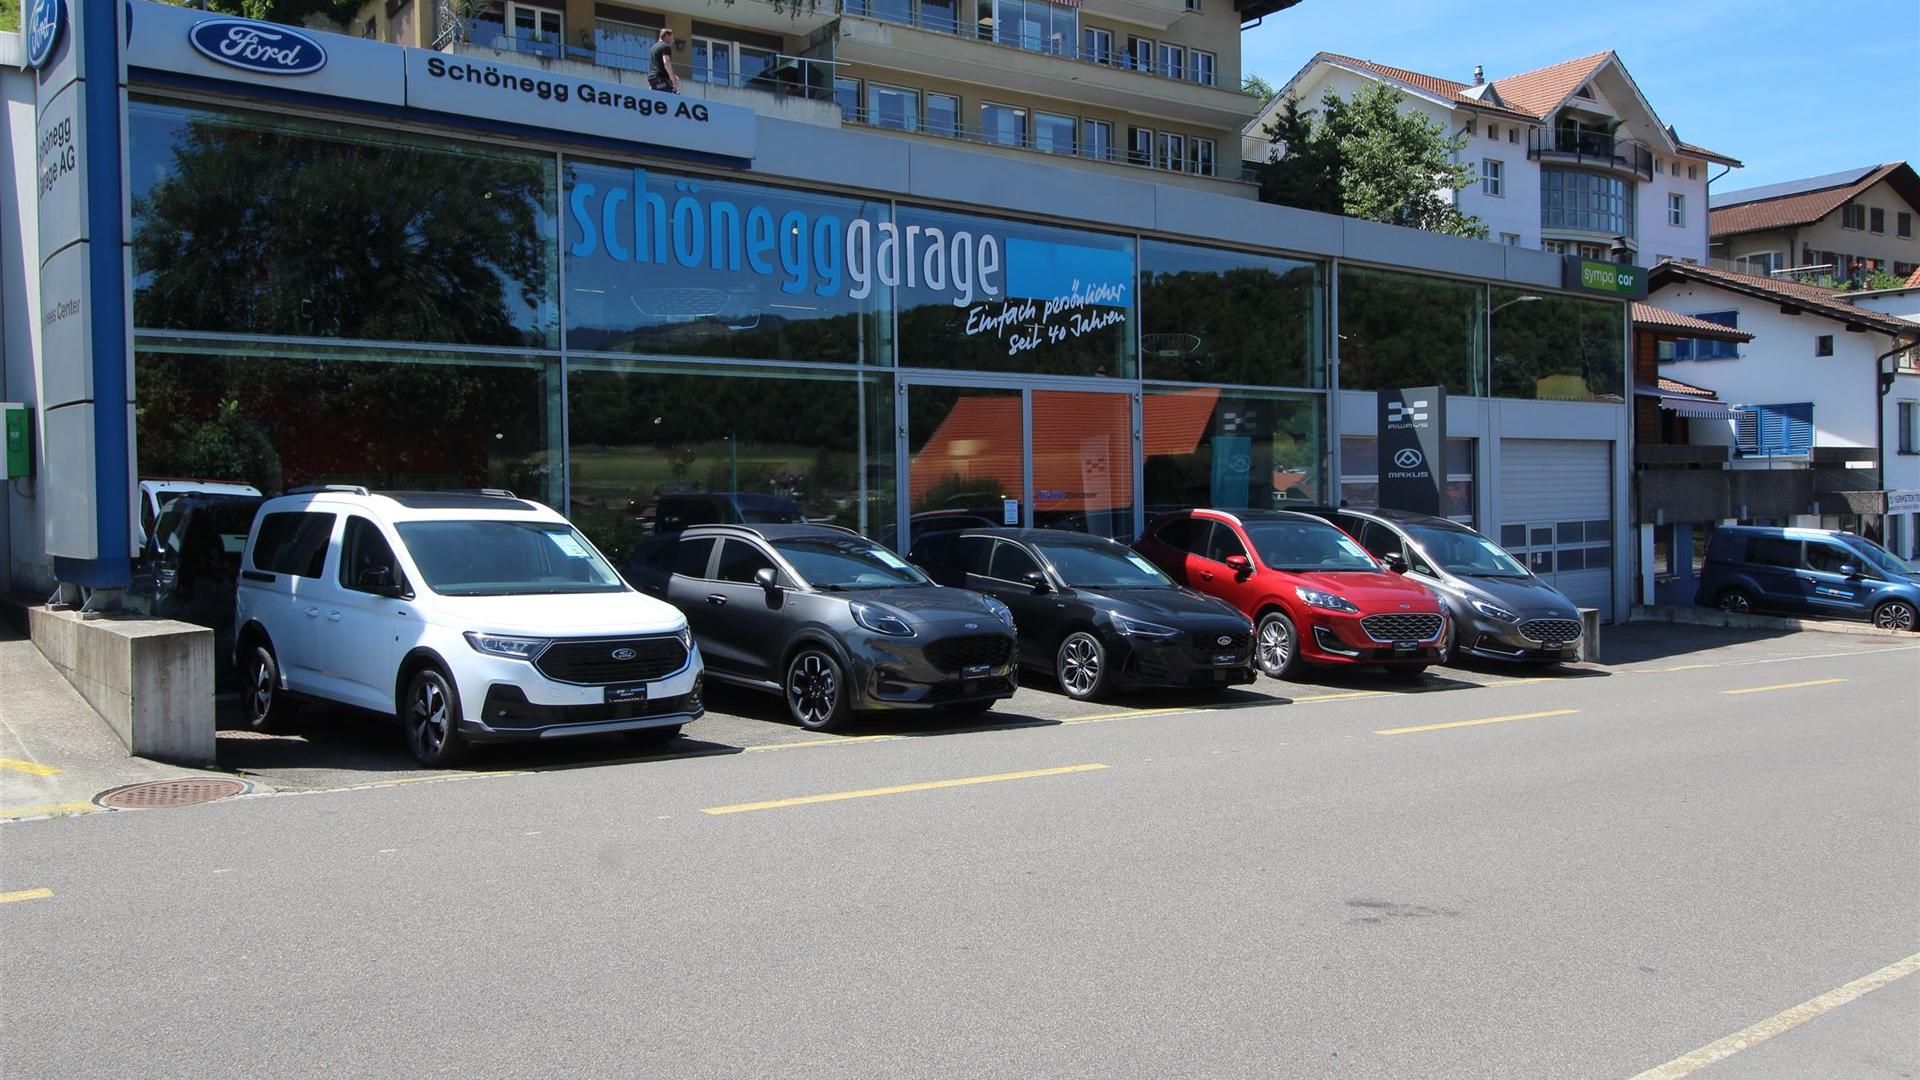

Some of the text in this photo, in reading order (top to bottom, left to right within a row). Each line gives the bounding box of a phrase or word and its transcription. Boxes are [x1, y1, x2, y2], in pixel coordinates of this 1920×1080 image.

[219, 26, 302, 66] Ford
[427, 57, 710, 122] Schönegg Garage AG
[59, 144, 76, 177] AG
[1617, 273, 1634, 287] car
[56, 298, 81, 320] Center
[965, 278, 1126, 339] Einfach persönlicher
[1008, 309, 1127, 356] seit 40 Jahren
